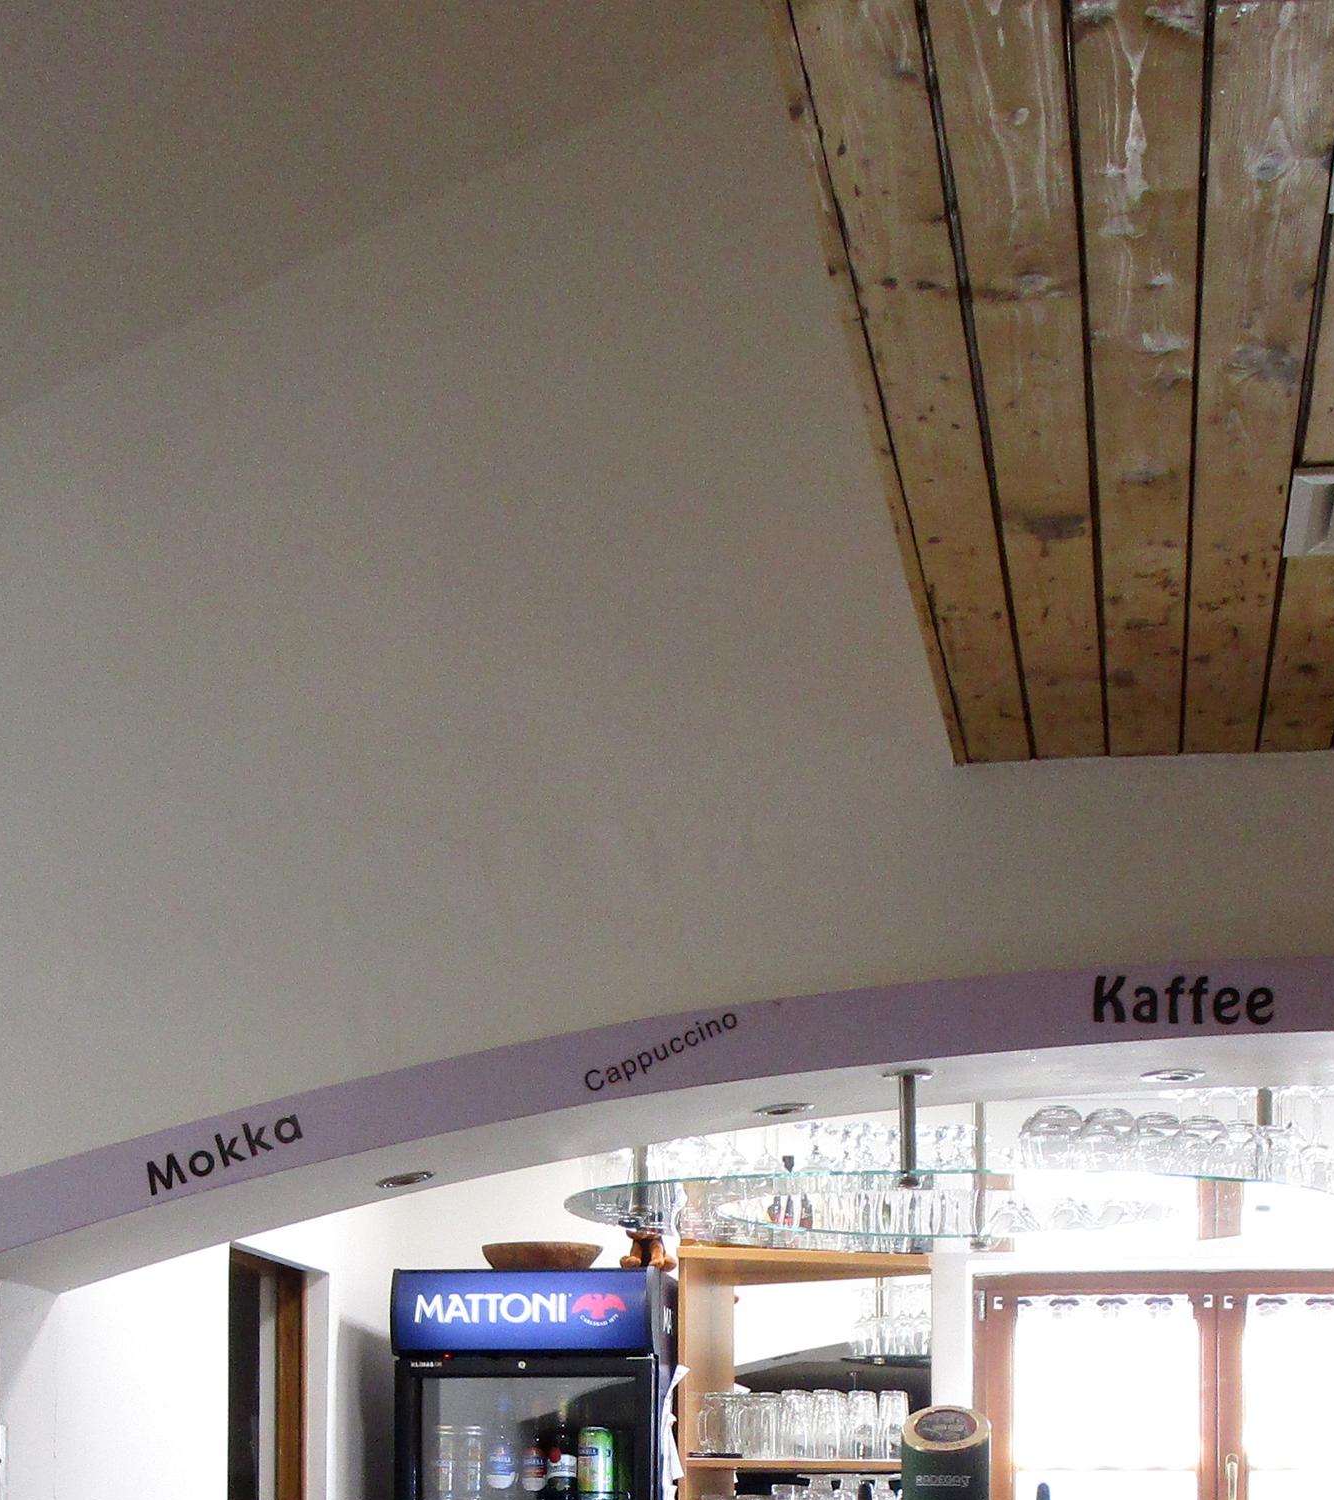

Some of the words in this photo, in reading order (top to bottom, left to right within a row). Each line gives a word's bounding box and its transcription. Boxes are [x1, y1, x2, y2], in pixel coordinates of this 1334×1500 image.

[1092, 975, 1275, 1025] Kaffee
[584, 1010, 738, 1092] Cappuccino
[146, 1112, 304, 1196] Mokka
[414, 1292, 568, 1324] MATTONI
[915, 1474, 972, 1488] RADEGAST
